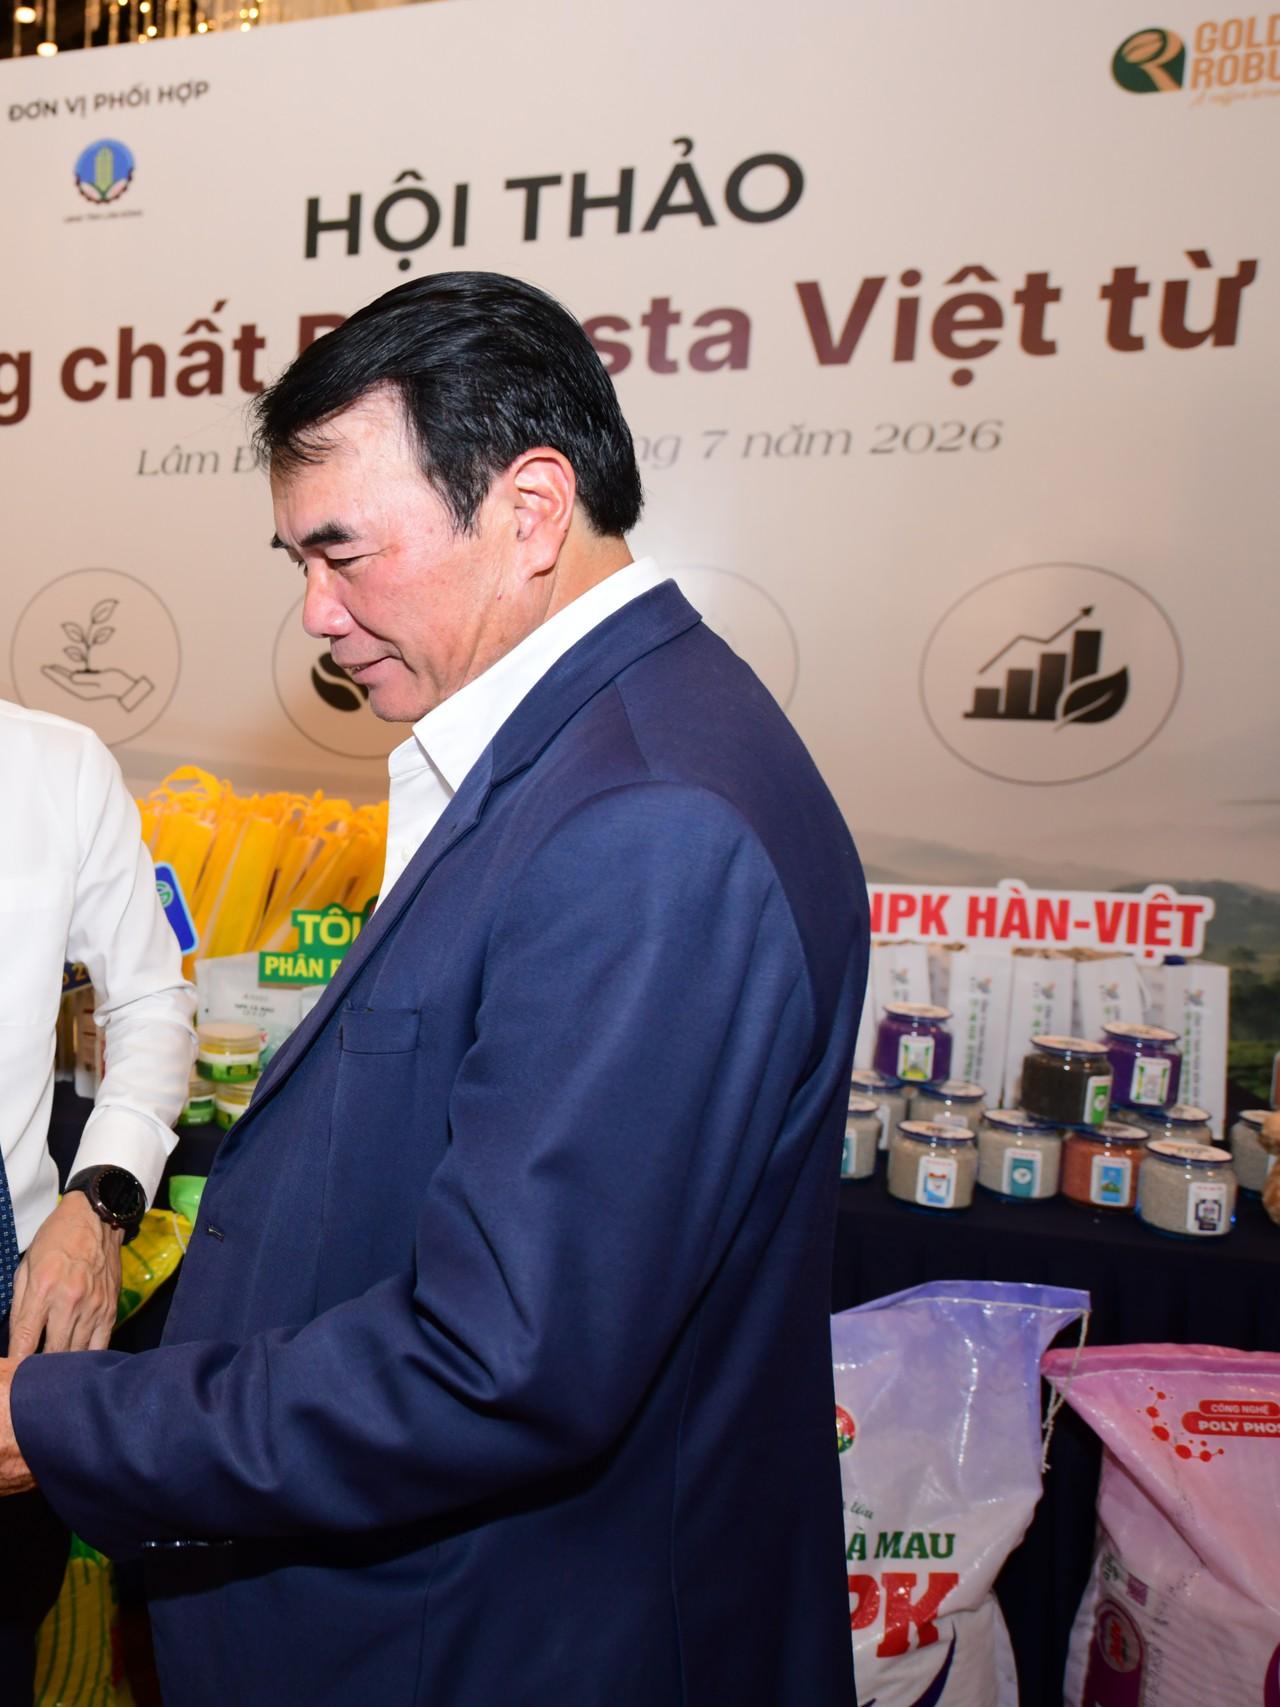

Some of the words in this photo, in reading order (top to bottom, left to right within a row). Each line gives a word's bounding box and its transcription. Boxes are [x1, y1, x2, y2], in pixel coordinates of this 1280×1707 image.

[9, 100, 57, 122] ĐƠN
[65, 95, 86, 117] VỊ
[94, 82, 150, 111] PHỐI
[158, 76, 209, 105] HỢP
[304, 171, 468, 271] HỘI
[505, 137, 805, 241] THẢO
[61, 300, 266, 402] chất
[795, 265, 1061, 387] Việt
[1100, 249, 1259, 352] từ
[138, 444, 219, 476] Lâm
[702, 430, 728, 460] 7
[741, 422, 853, 460] năm
[869, 420, 1004, 456] 2026
[297, 907, 362, 947] TÔI
[966, 887, 1204, 959] HÀN-VIỆT
[265, 953, 323, 978] PHÂN
[1199, 1421, 1239, 1432] POLY
[847, 1526, 867, 1560] À
[874, 1531, 956, 1559] MAU
[847, 1572, 960, 1658] PK
